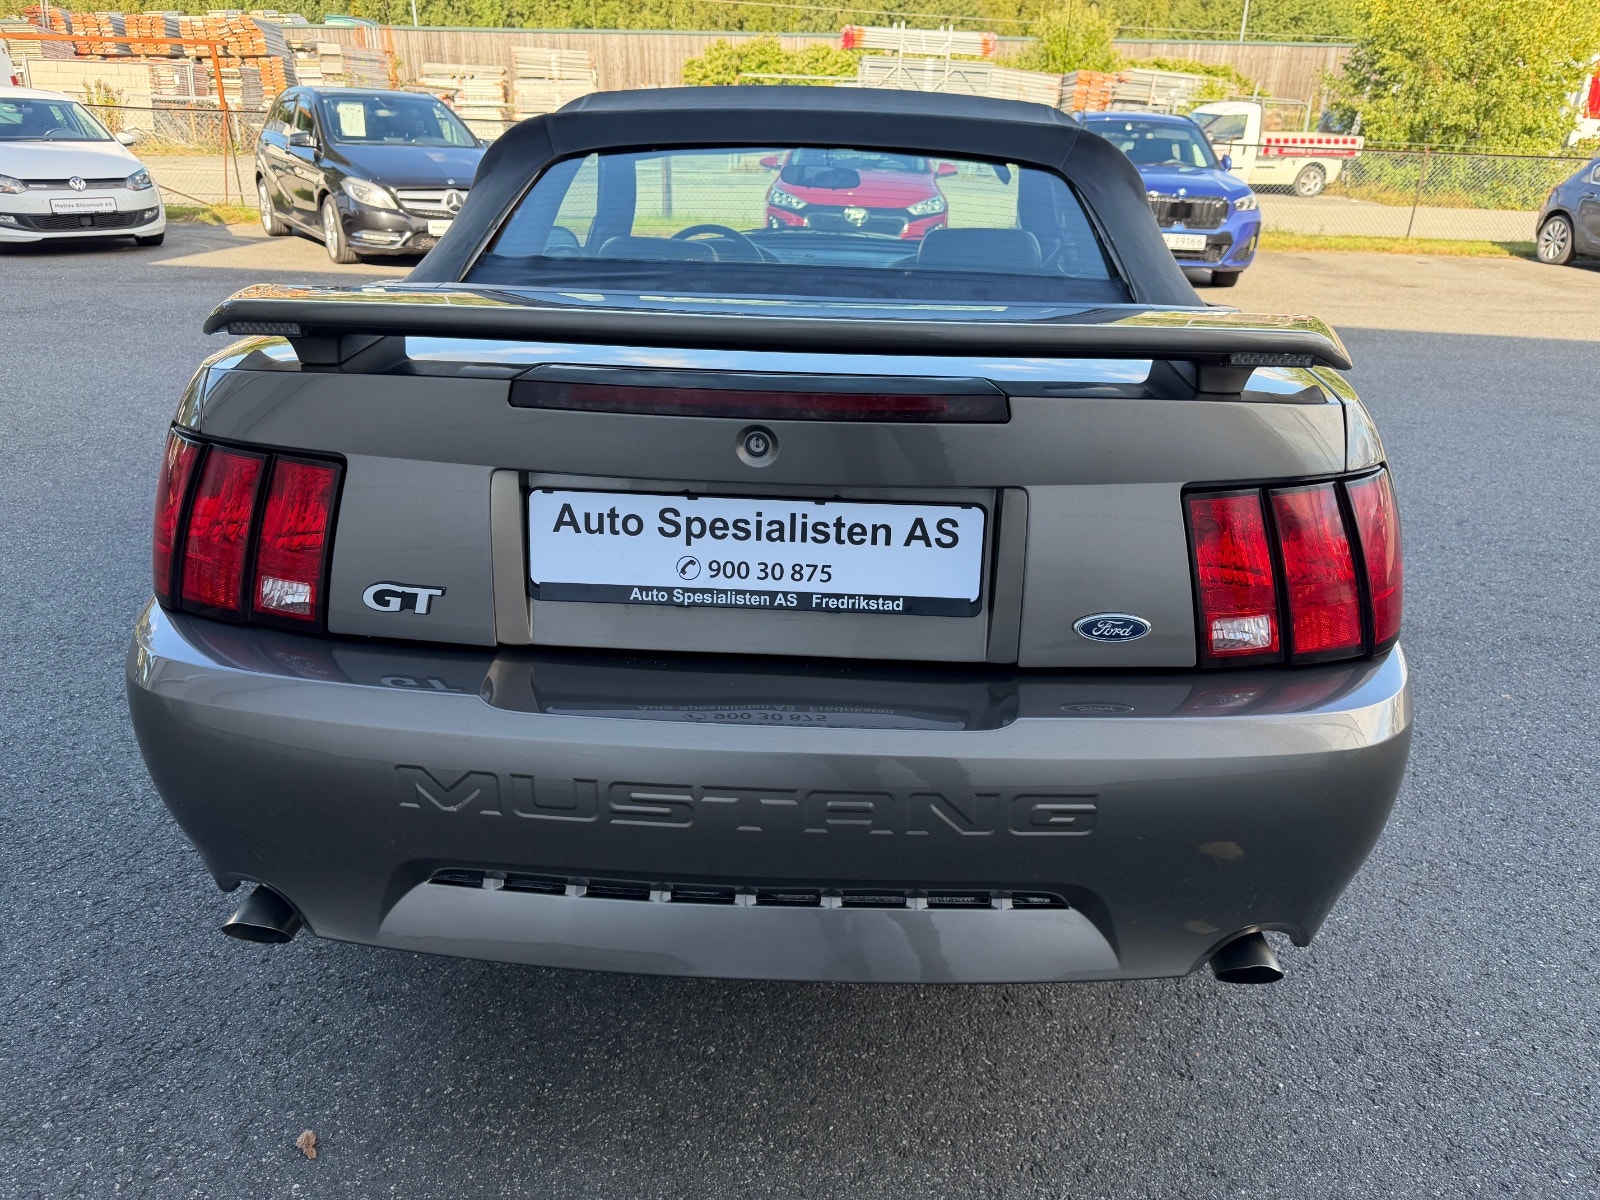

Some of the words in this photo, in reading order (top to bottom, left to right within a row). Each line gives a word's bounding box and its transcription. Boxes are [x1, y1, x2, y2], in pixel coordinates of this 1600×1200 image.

[552, 503, 644, 537] Auto
[657, 507, 892, 547] Spesialisten
[903, 517, 960, 549] AS
[708, 559, 750, 581] 900
[756, 561, 785, 582] 30
[790, 563, 832, 583] 875
[362, 580, 447, 615] GT
[629, 587, 669, 602] Auto
[672, 588, 770, 606] Spesialisten
[773, 593, 798, 607] AS
[811, 594, 904, 611] Fredrikstad
[1092, 619, 1134, 637] Ford
[394, 763, 1099, 837] MUSTANG
